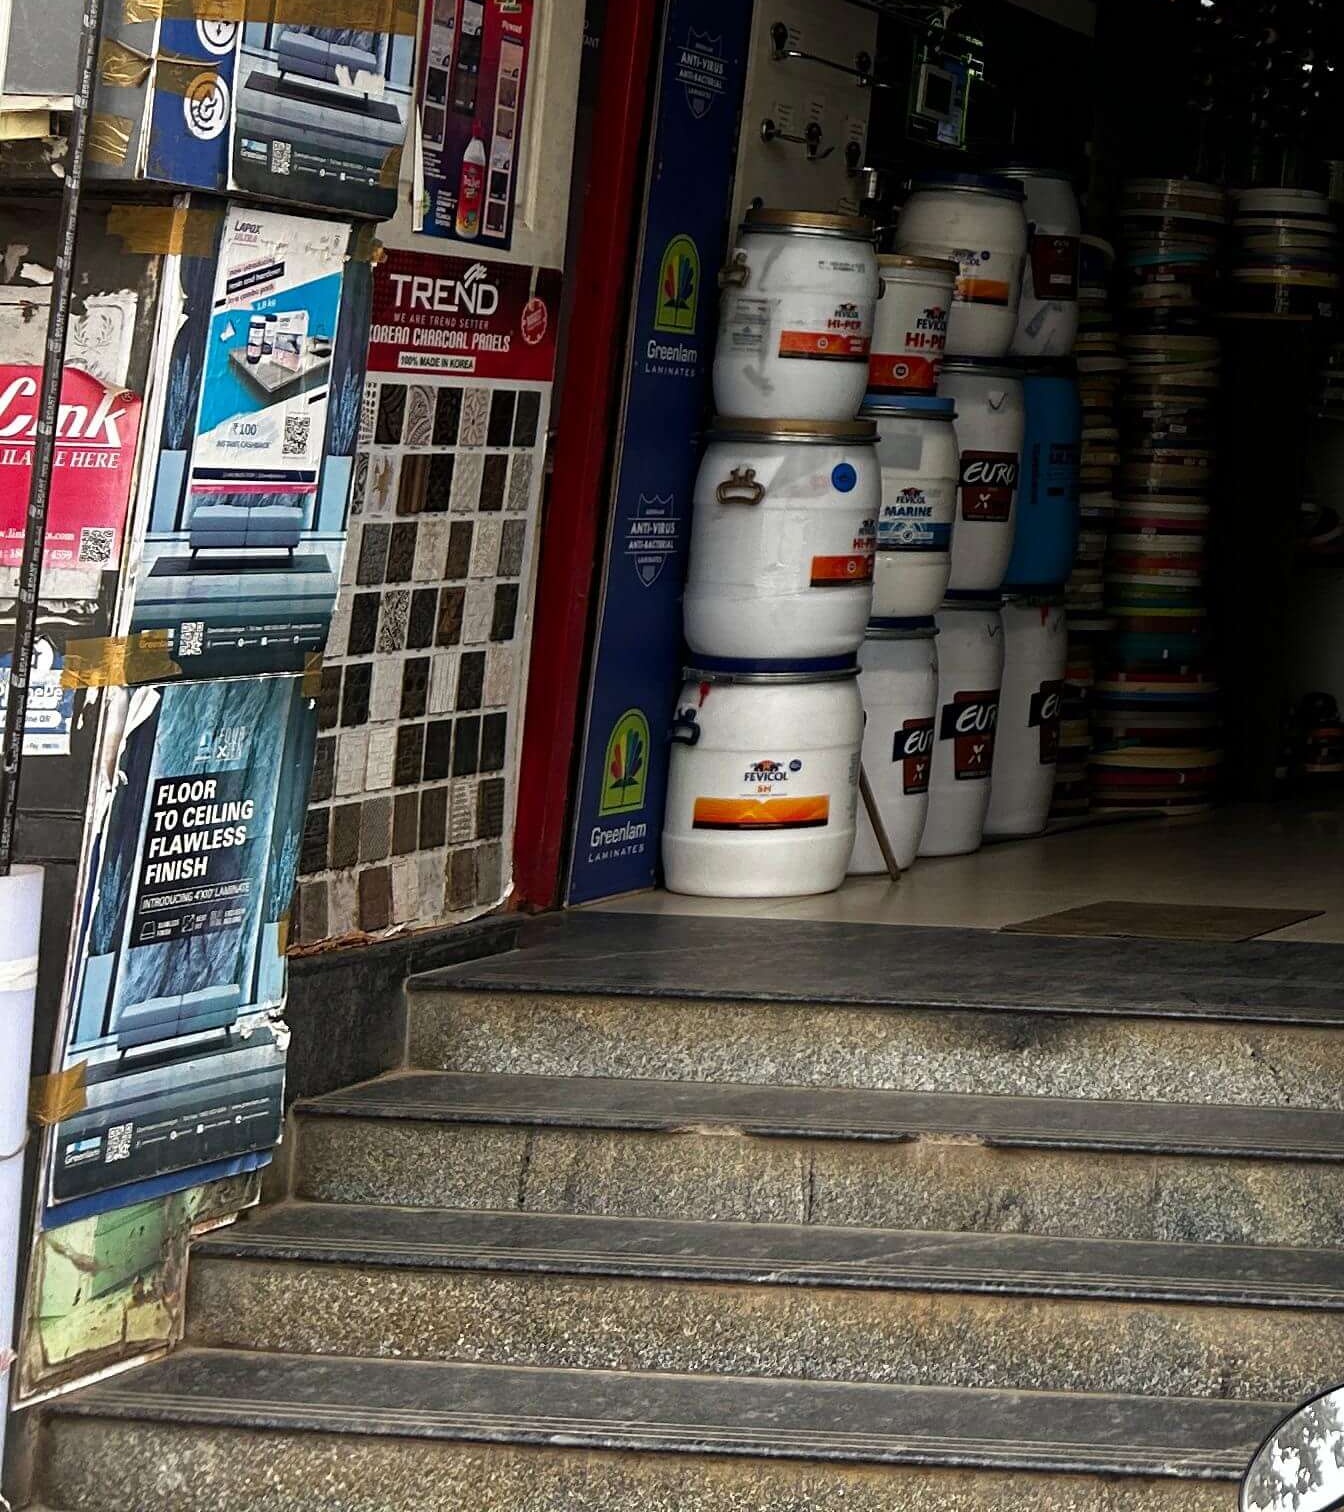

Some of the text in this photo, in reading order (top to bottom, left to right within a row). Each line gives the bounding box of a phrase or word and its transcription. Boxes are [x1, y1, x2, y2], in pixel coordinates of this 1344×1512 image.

[390, 274, 499, 316] TREND
[393, 312, 489, 330] WE ARE TREND SETTER
[413, 328, 468, 349] CHARCOAL
[472, 333, 511, 353] PANELS
[420, 356, 441, 367] MADE
[442, 357, 449, 368] IN
[450, 357, 473, 369] KOREA
[646, 340, 698, 365] Greenlam
[644, 364, 697, 378] LAMINATES
[0, 376, 127, 447] Lnk
[70, 450, 120, 468] HERE
[885, 506, 932, 517] MARINE
[630, 520, 676, 536] ANTI-VIRUS
[627, 538, 674, 551] ANTI-BACTERIAL
[744, 771, 788, 782] FEVICOL
[157, 779, 217, 806] FLOOR
[154, 800, 254, 832] TO CEILING
[149, 825, 247, 859] FLAWLESS
[590, 821, 647, 849] Greenlam
[588, 844, 645, 864] LAMINATES
[145, 856, 208, 885] FINISH
